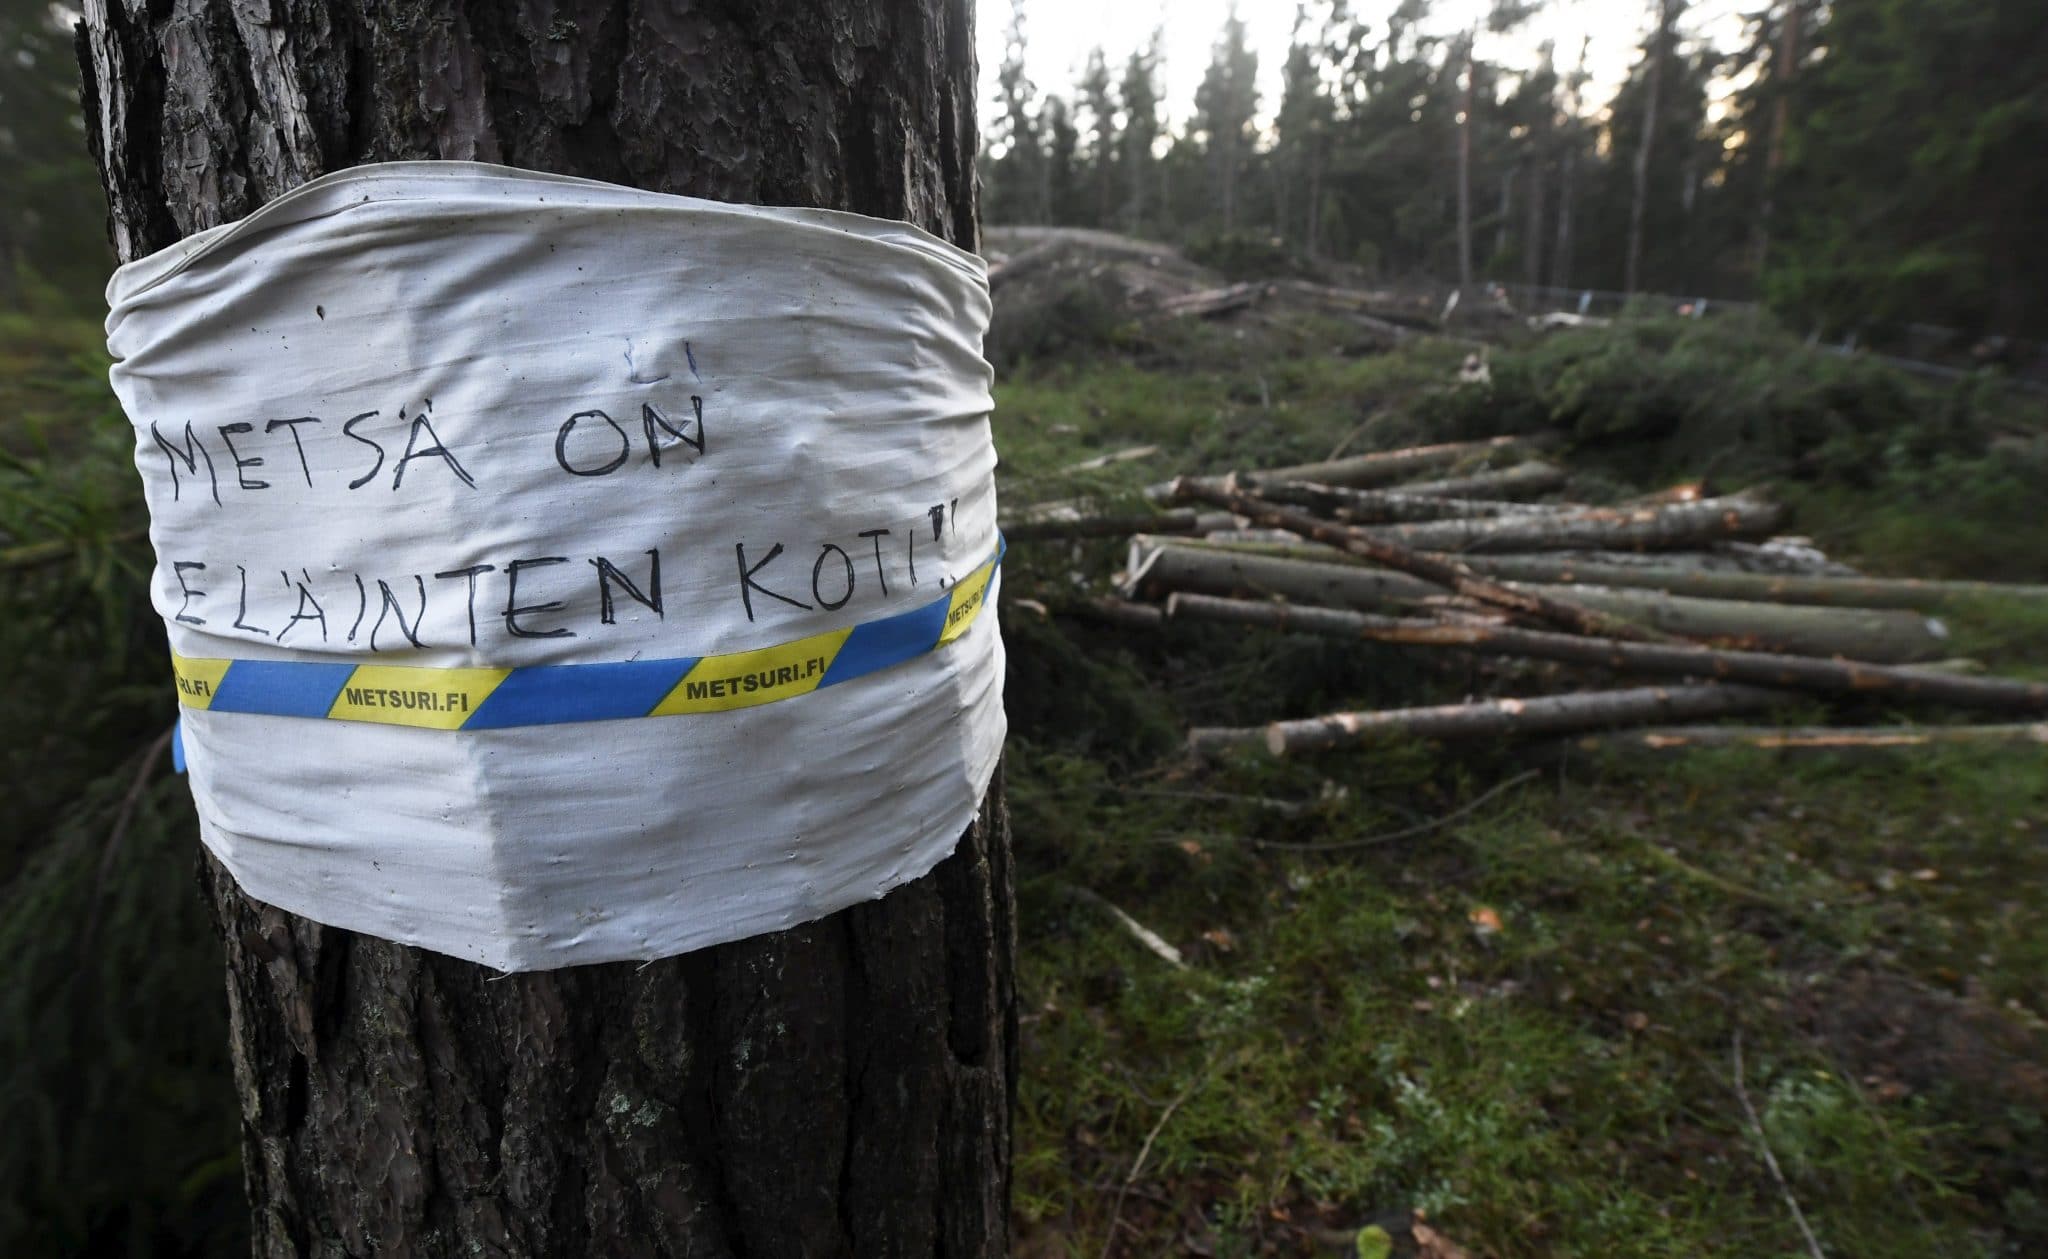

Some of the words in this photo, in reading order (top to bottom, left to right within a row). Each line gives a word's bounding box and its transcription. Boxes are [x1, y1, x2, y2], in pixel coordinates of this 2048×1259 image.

[151, 398, 477, 508] METSÄ
[555, 395, 704, 476] ON
[173, 548, 663, 651] ELÄINTEN
[346, 688, 468, 713] METSURI.FI
[687, 657, 825, 699] METSURI.FI
